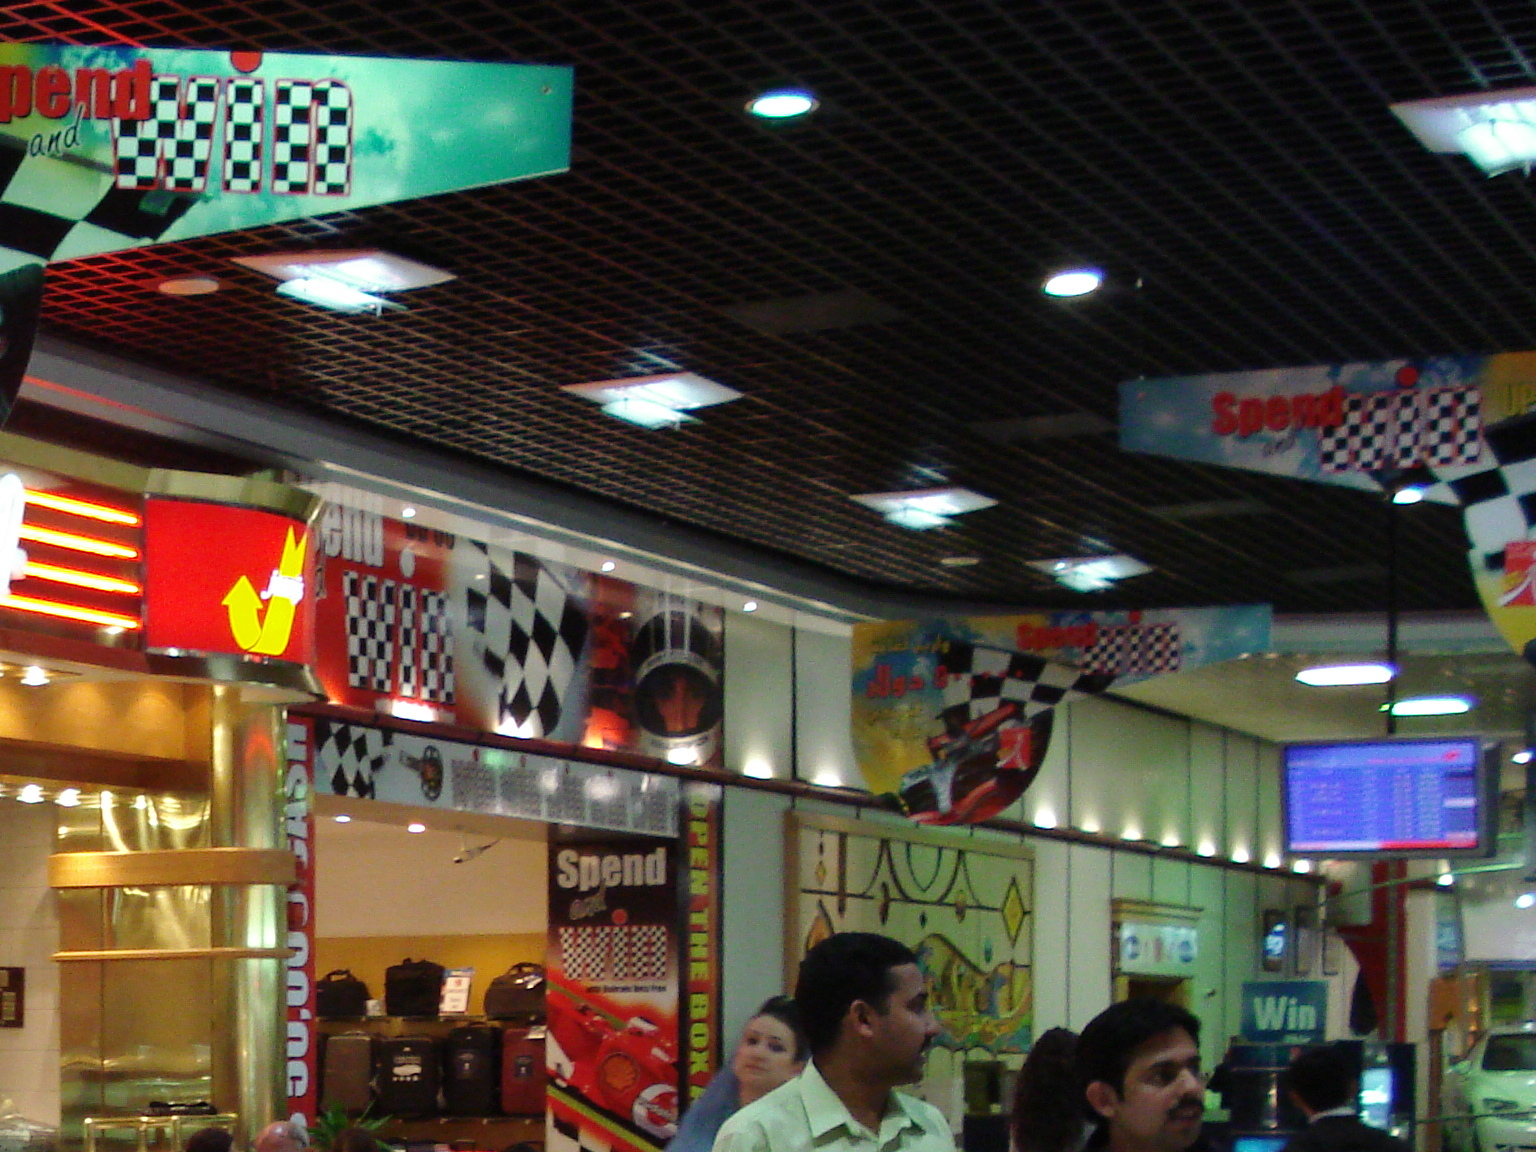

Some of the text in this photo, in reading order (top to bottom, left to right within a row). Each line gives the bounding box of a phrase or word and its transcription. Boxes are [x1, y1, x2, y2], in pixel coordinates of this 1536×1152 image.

[27, 102, 86, 158] and
[1211, 384, 1346, 438] Spend
[556, 847, 667, 892] Spend
[691, 907, 711, 980] THE
[690, 993, 711, 1077] BOX
[1253, 995, 1317, 1031] Win
